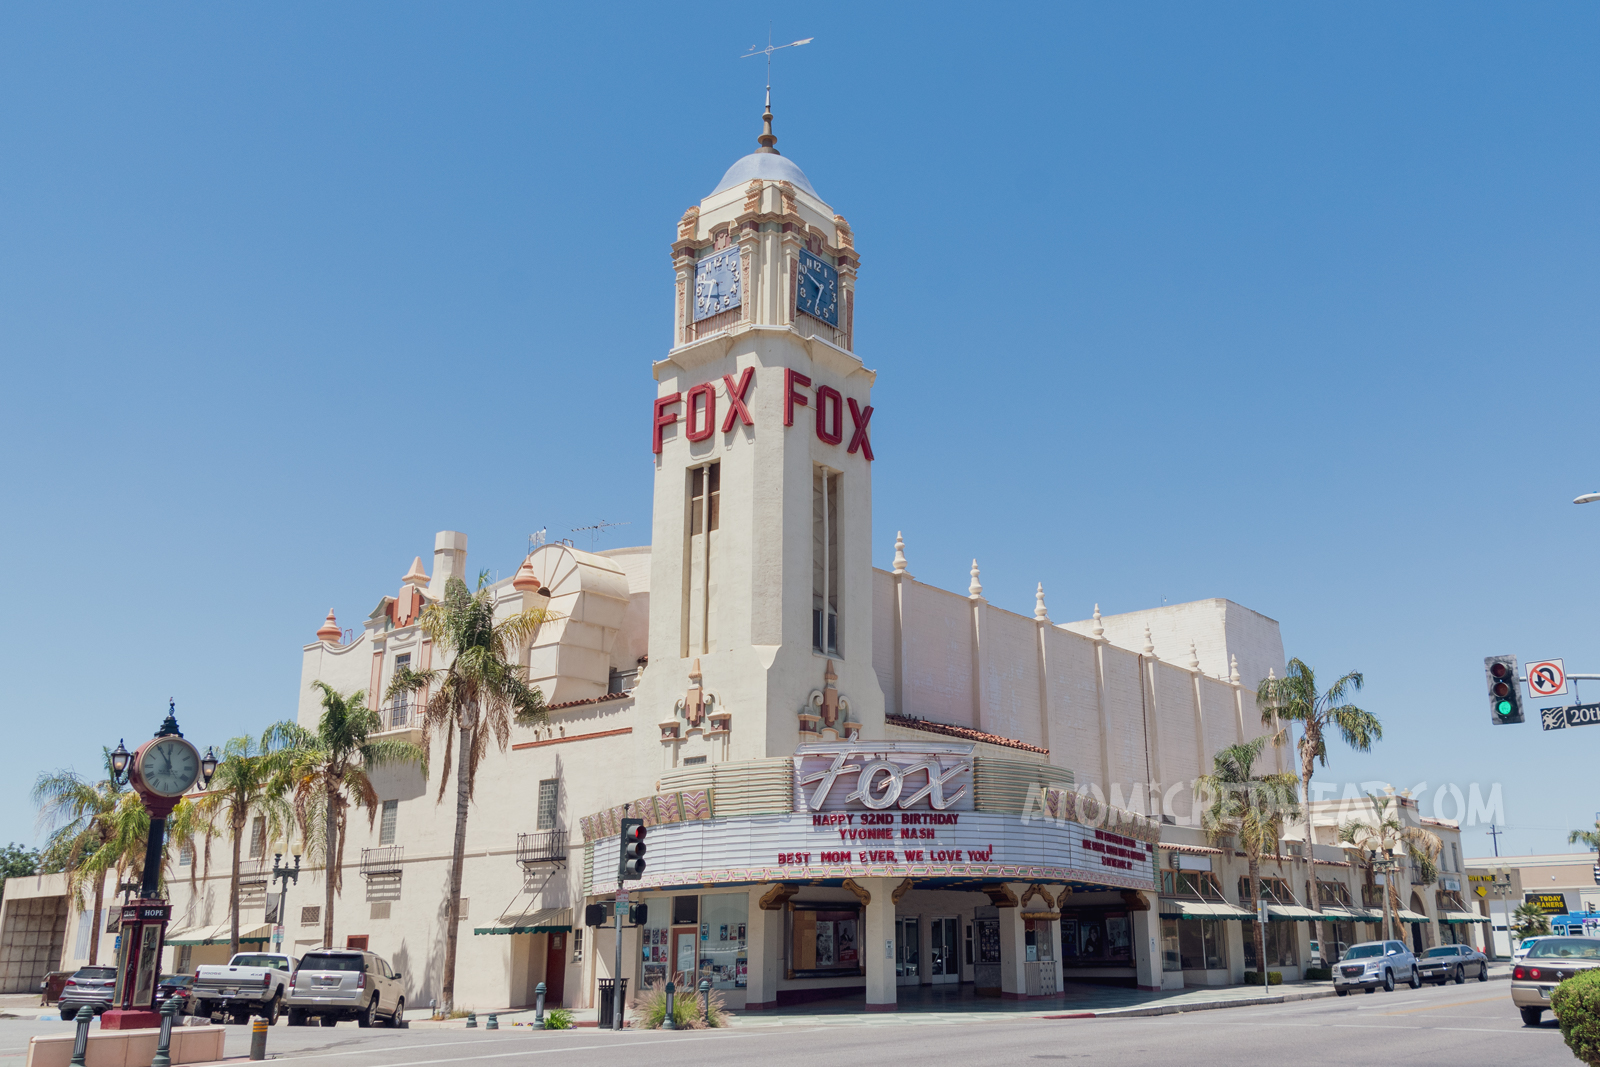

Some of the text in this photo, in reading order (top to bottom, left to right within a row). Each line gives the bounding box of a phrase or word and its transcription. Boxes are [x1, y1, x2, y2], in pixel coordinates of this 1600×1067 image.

[714, 256, 722, 268] 12
[730, 260, 737, 272] 2
[806, 258, 812, 269] 11
[814, 260, 821, 272] 12
[706, 262, 712, 274] 11
[800, 262, 807, 274] 10
[734, 271, 739, 282] 3
[799, 275, 804, 284] 9
[730, 284, 737, 294] 4
[829, 280, 834, 290] 2
[696, 286, 702, 297] 9
[800, 288, 806, 298] 8
[832, 292, 836, 302] 3
[698, 297, 704, 307] 8
[724, 296, 730, 306] 5
[806, 299, 811, 308] 7
[714, 302, 720, 312] 6
[815, 307, 820, 316] 6
[829, 304, 834, 313] 4
[823, 308, 828, 318] 5
[652, 366, 755, 454] FOX
[784, 368, 874, 462] FOX
[813, 813, 959, 826] HAPPY 92ND BIRTHDAY
[839, 828, 935, 840] YVONNE NASH
[778, 844, 993, 864] BEST MOM EVER, WE LOVE YOU!
